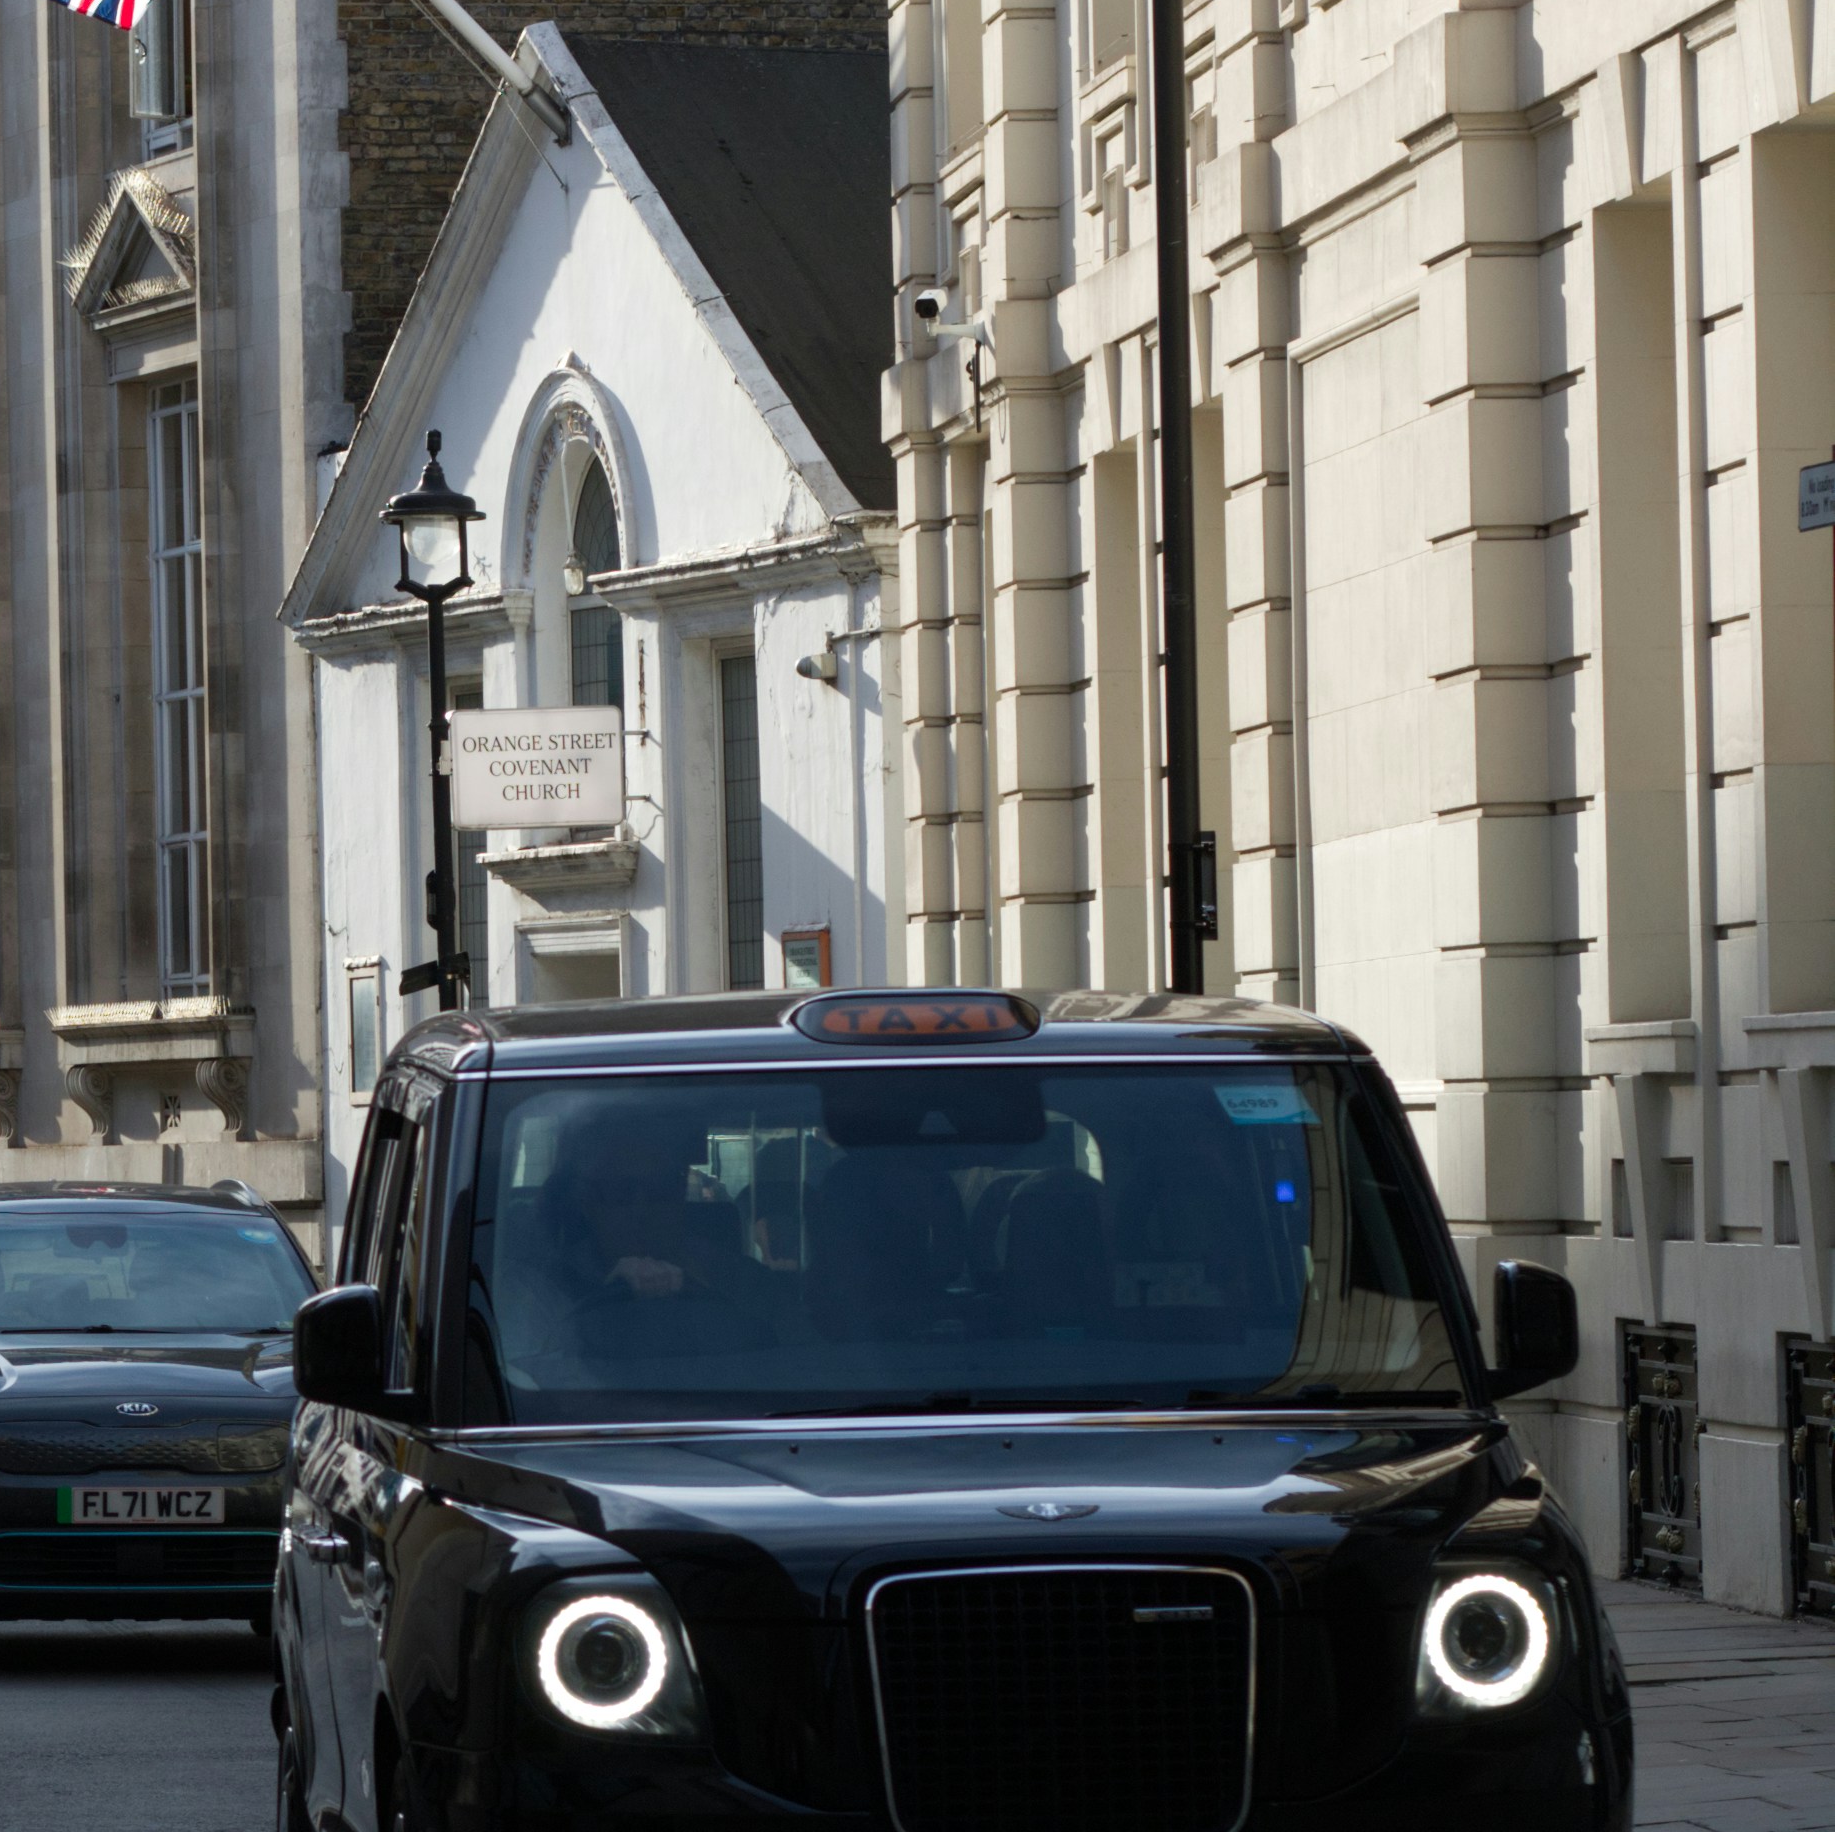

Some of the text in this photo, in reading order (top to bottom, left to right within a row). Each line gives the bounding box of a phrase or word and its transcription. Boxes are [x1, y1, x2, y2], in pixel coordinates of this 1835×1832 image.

[462, 732, 616, 754] ORANGE STREET
[489, 757, 592, 777] COVENANT
[502, 782, 581, 802] CHURCH
[838, 1006, 999, 1032] TAXI
[123, 1403, 151, 1412] KIA
[82, 1491, 212, 1518] FL71 WCZ
